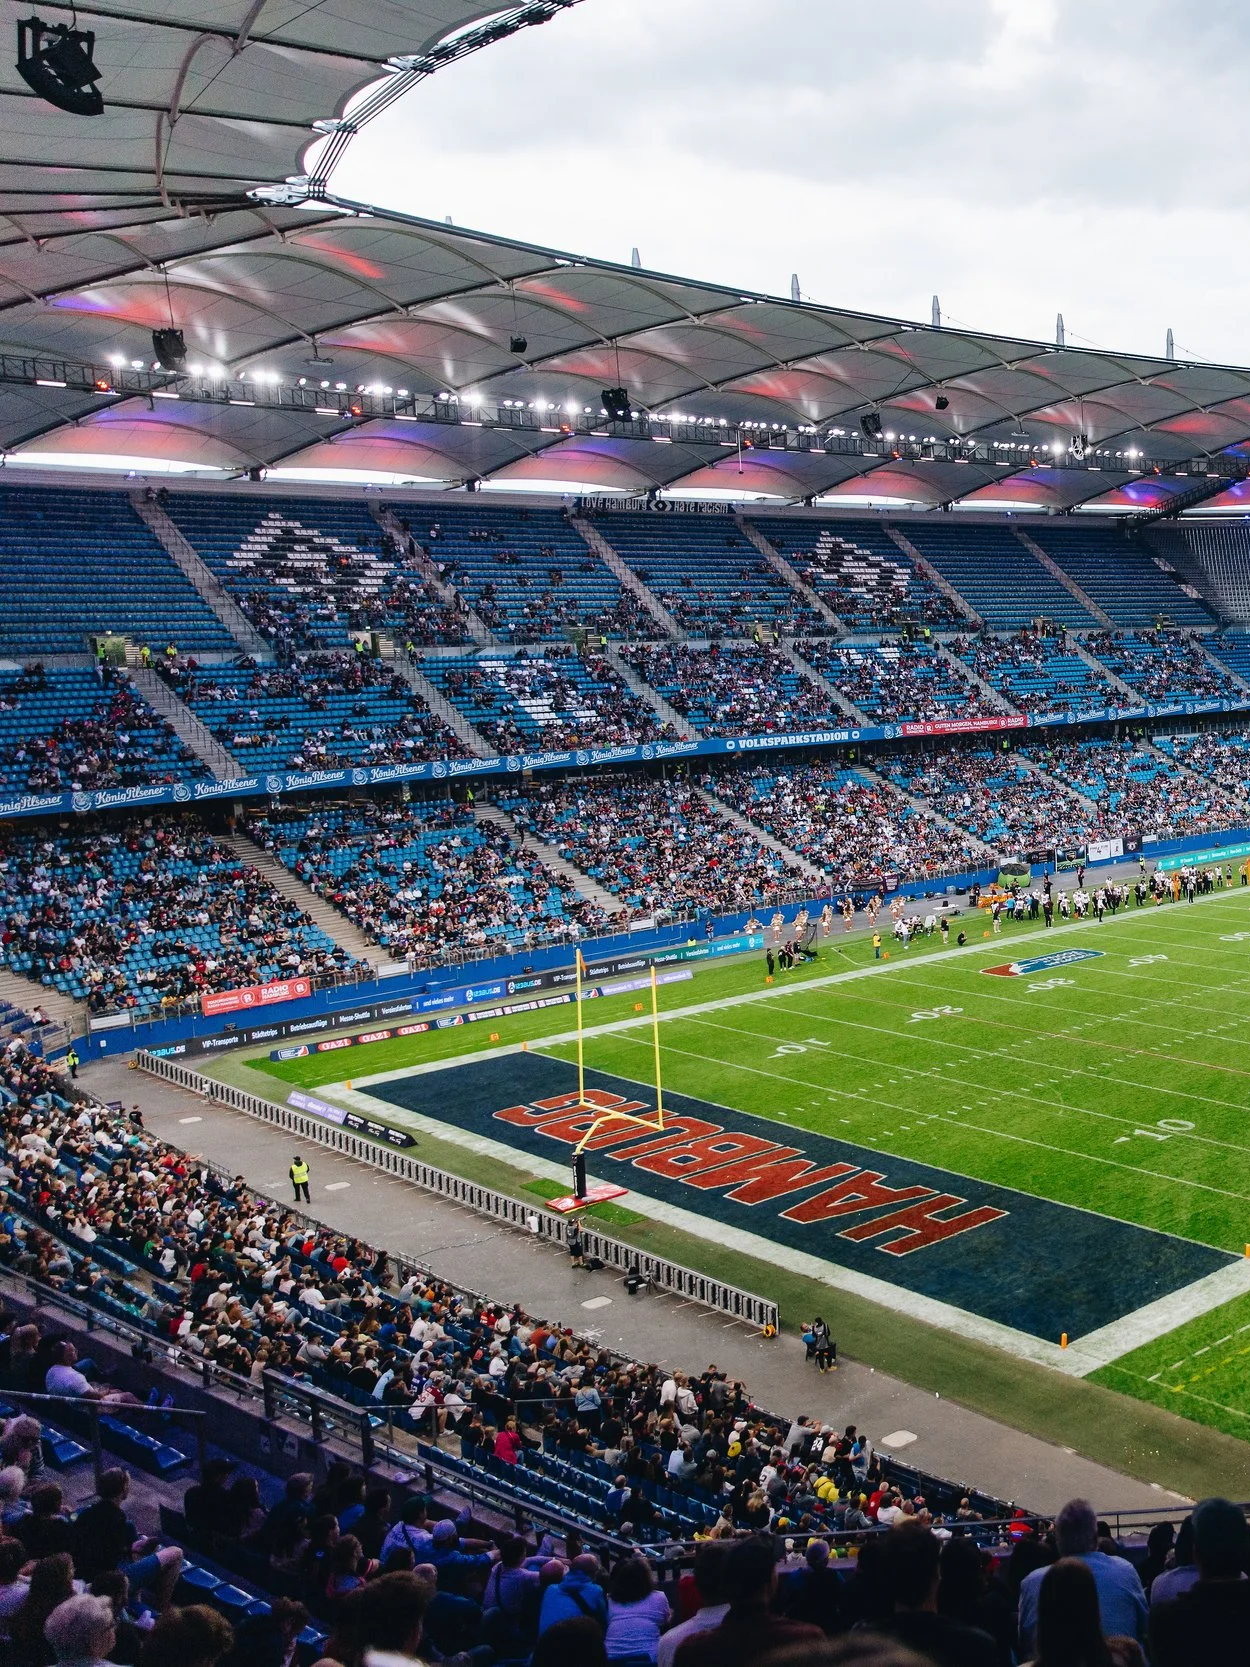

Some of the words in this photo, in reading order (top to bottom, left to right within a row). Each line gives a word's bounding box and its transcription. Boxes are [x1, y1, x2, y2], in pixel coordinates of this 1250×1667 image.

[738, 731, 849, 749] VOLKSPARKSTADION
[523, 752, 570, 767] KönigPilsener
[592, 747, 636, 762] KönigPilsener
[371, 764, 426, 780] KönigPilsener
[449, 758, 500, 774] KönigPilsener
[195, 778, 258, 797] KönigPilsener
[286, 771, 345, 788] KönigPilsener
[261, 984, 289, 995] RADIO
[1027, 978, 1076, 990] 30
[911, 1004, 963, 1021] 20
[776, 1038, 832, 1055] 10
[1134, 1118, 1196, 1142] 10
[492, 1088, 1010, 1257] HAMBURG
